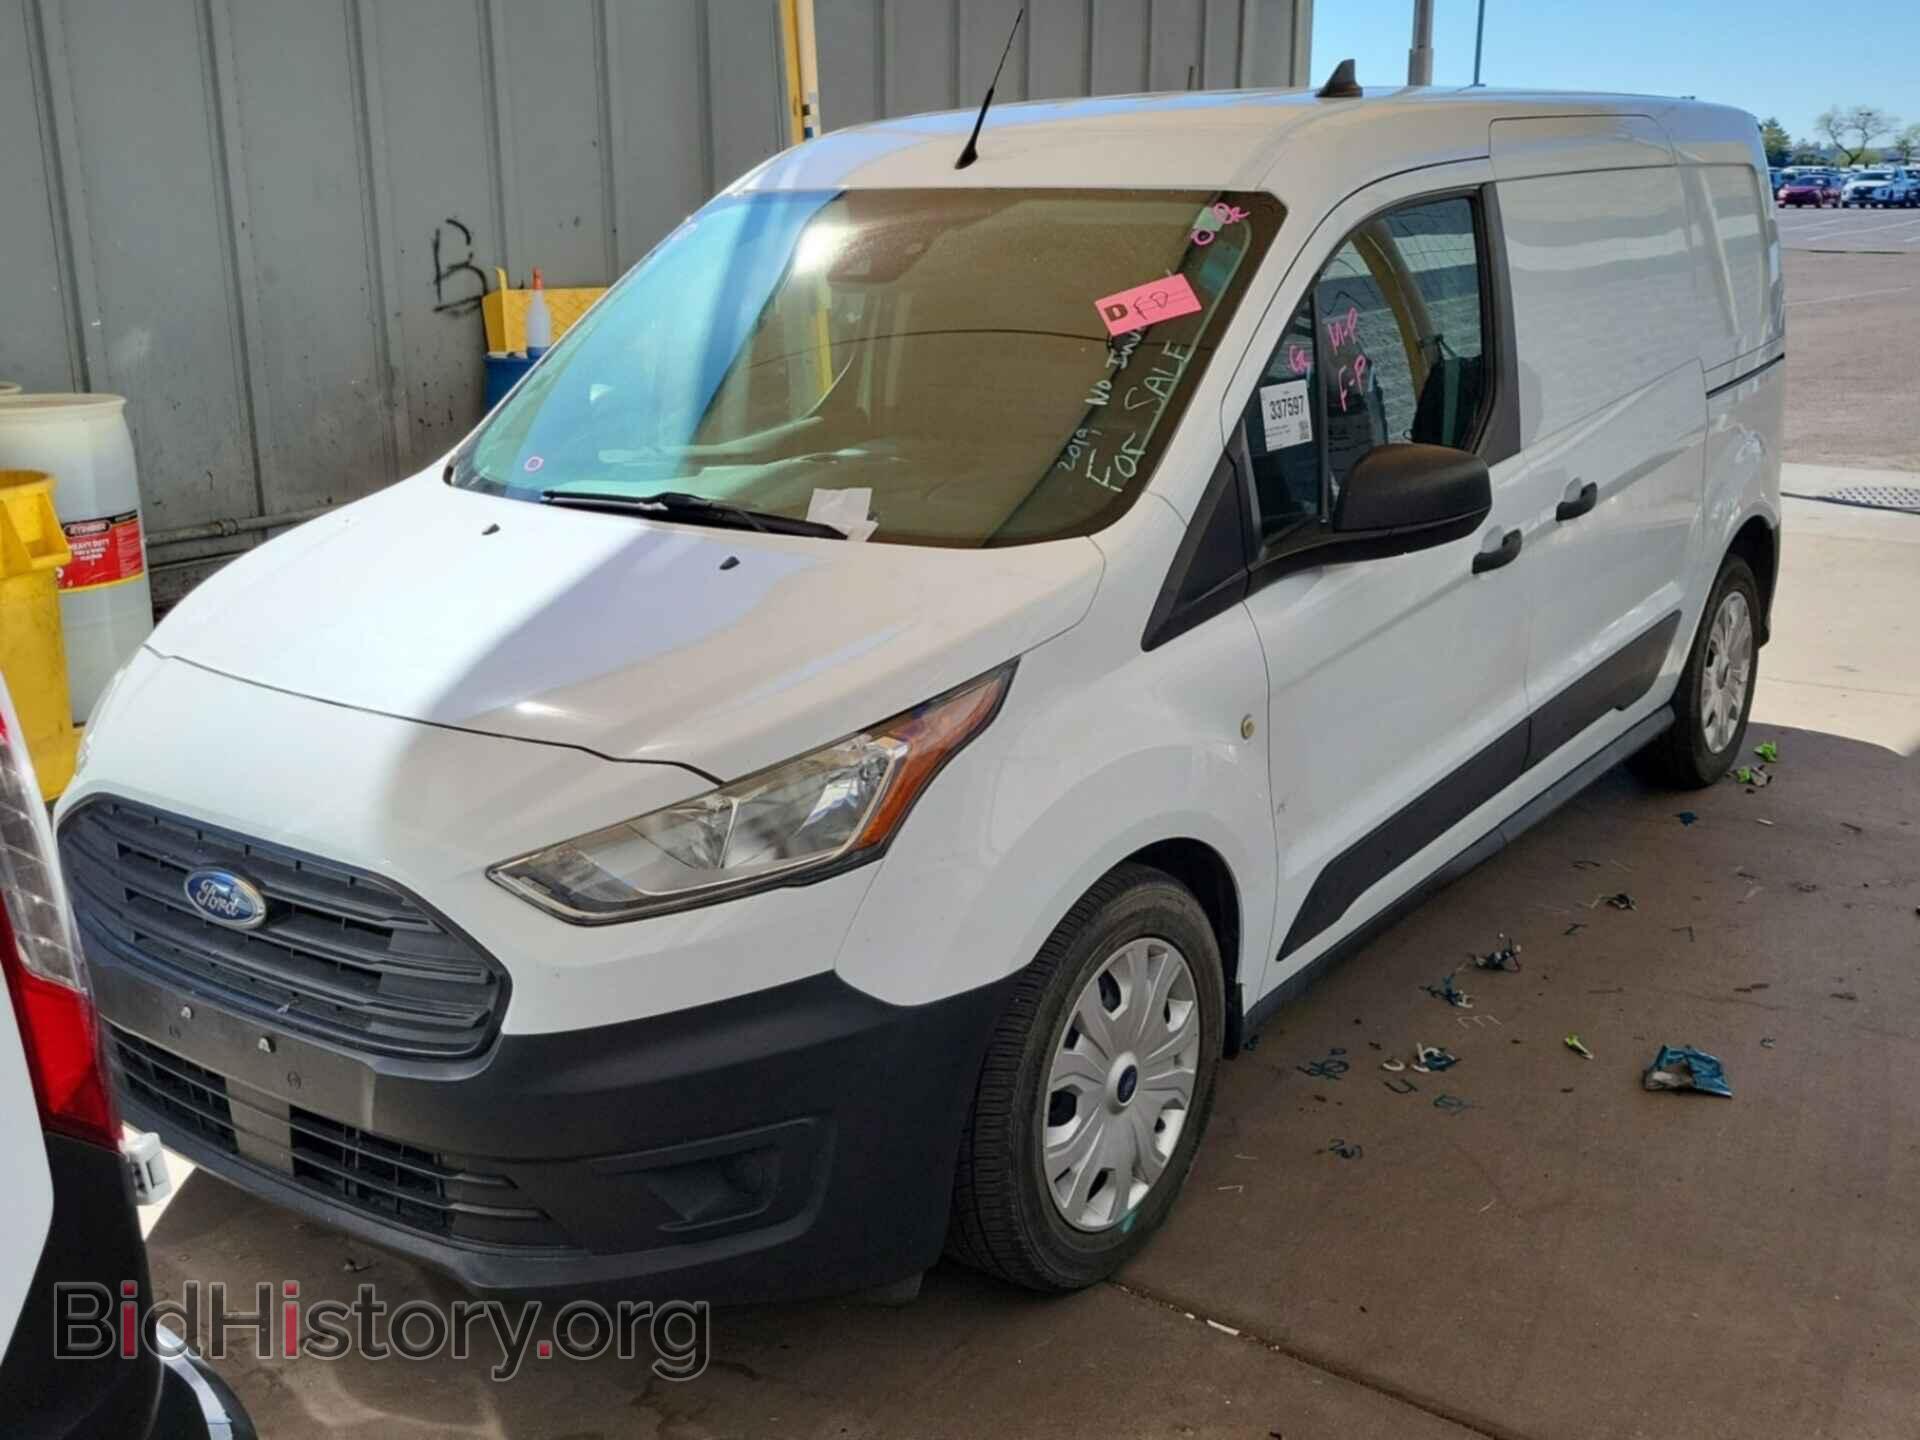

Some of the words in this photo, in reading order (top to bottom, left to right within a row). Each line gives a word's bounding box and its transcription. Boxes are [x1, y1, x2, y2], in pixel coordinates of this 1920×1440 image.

[1104, 303, 1128, 322] D
[1268, 394, 1305, 421] 337597
[195, 879, 241, 918] Ford
